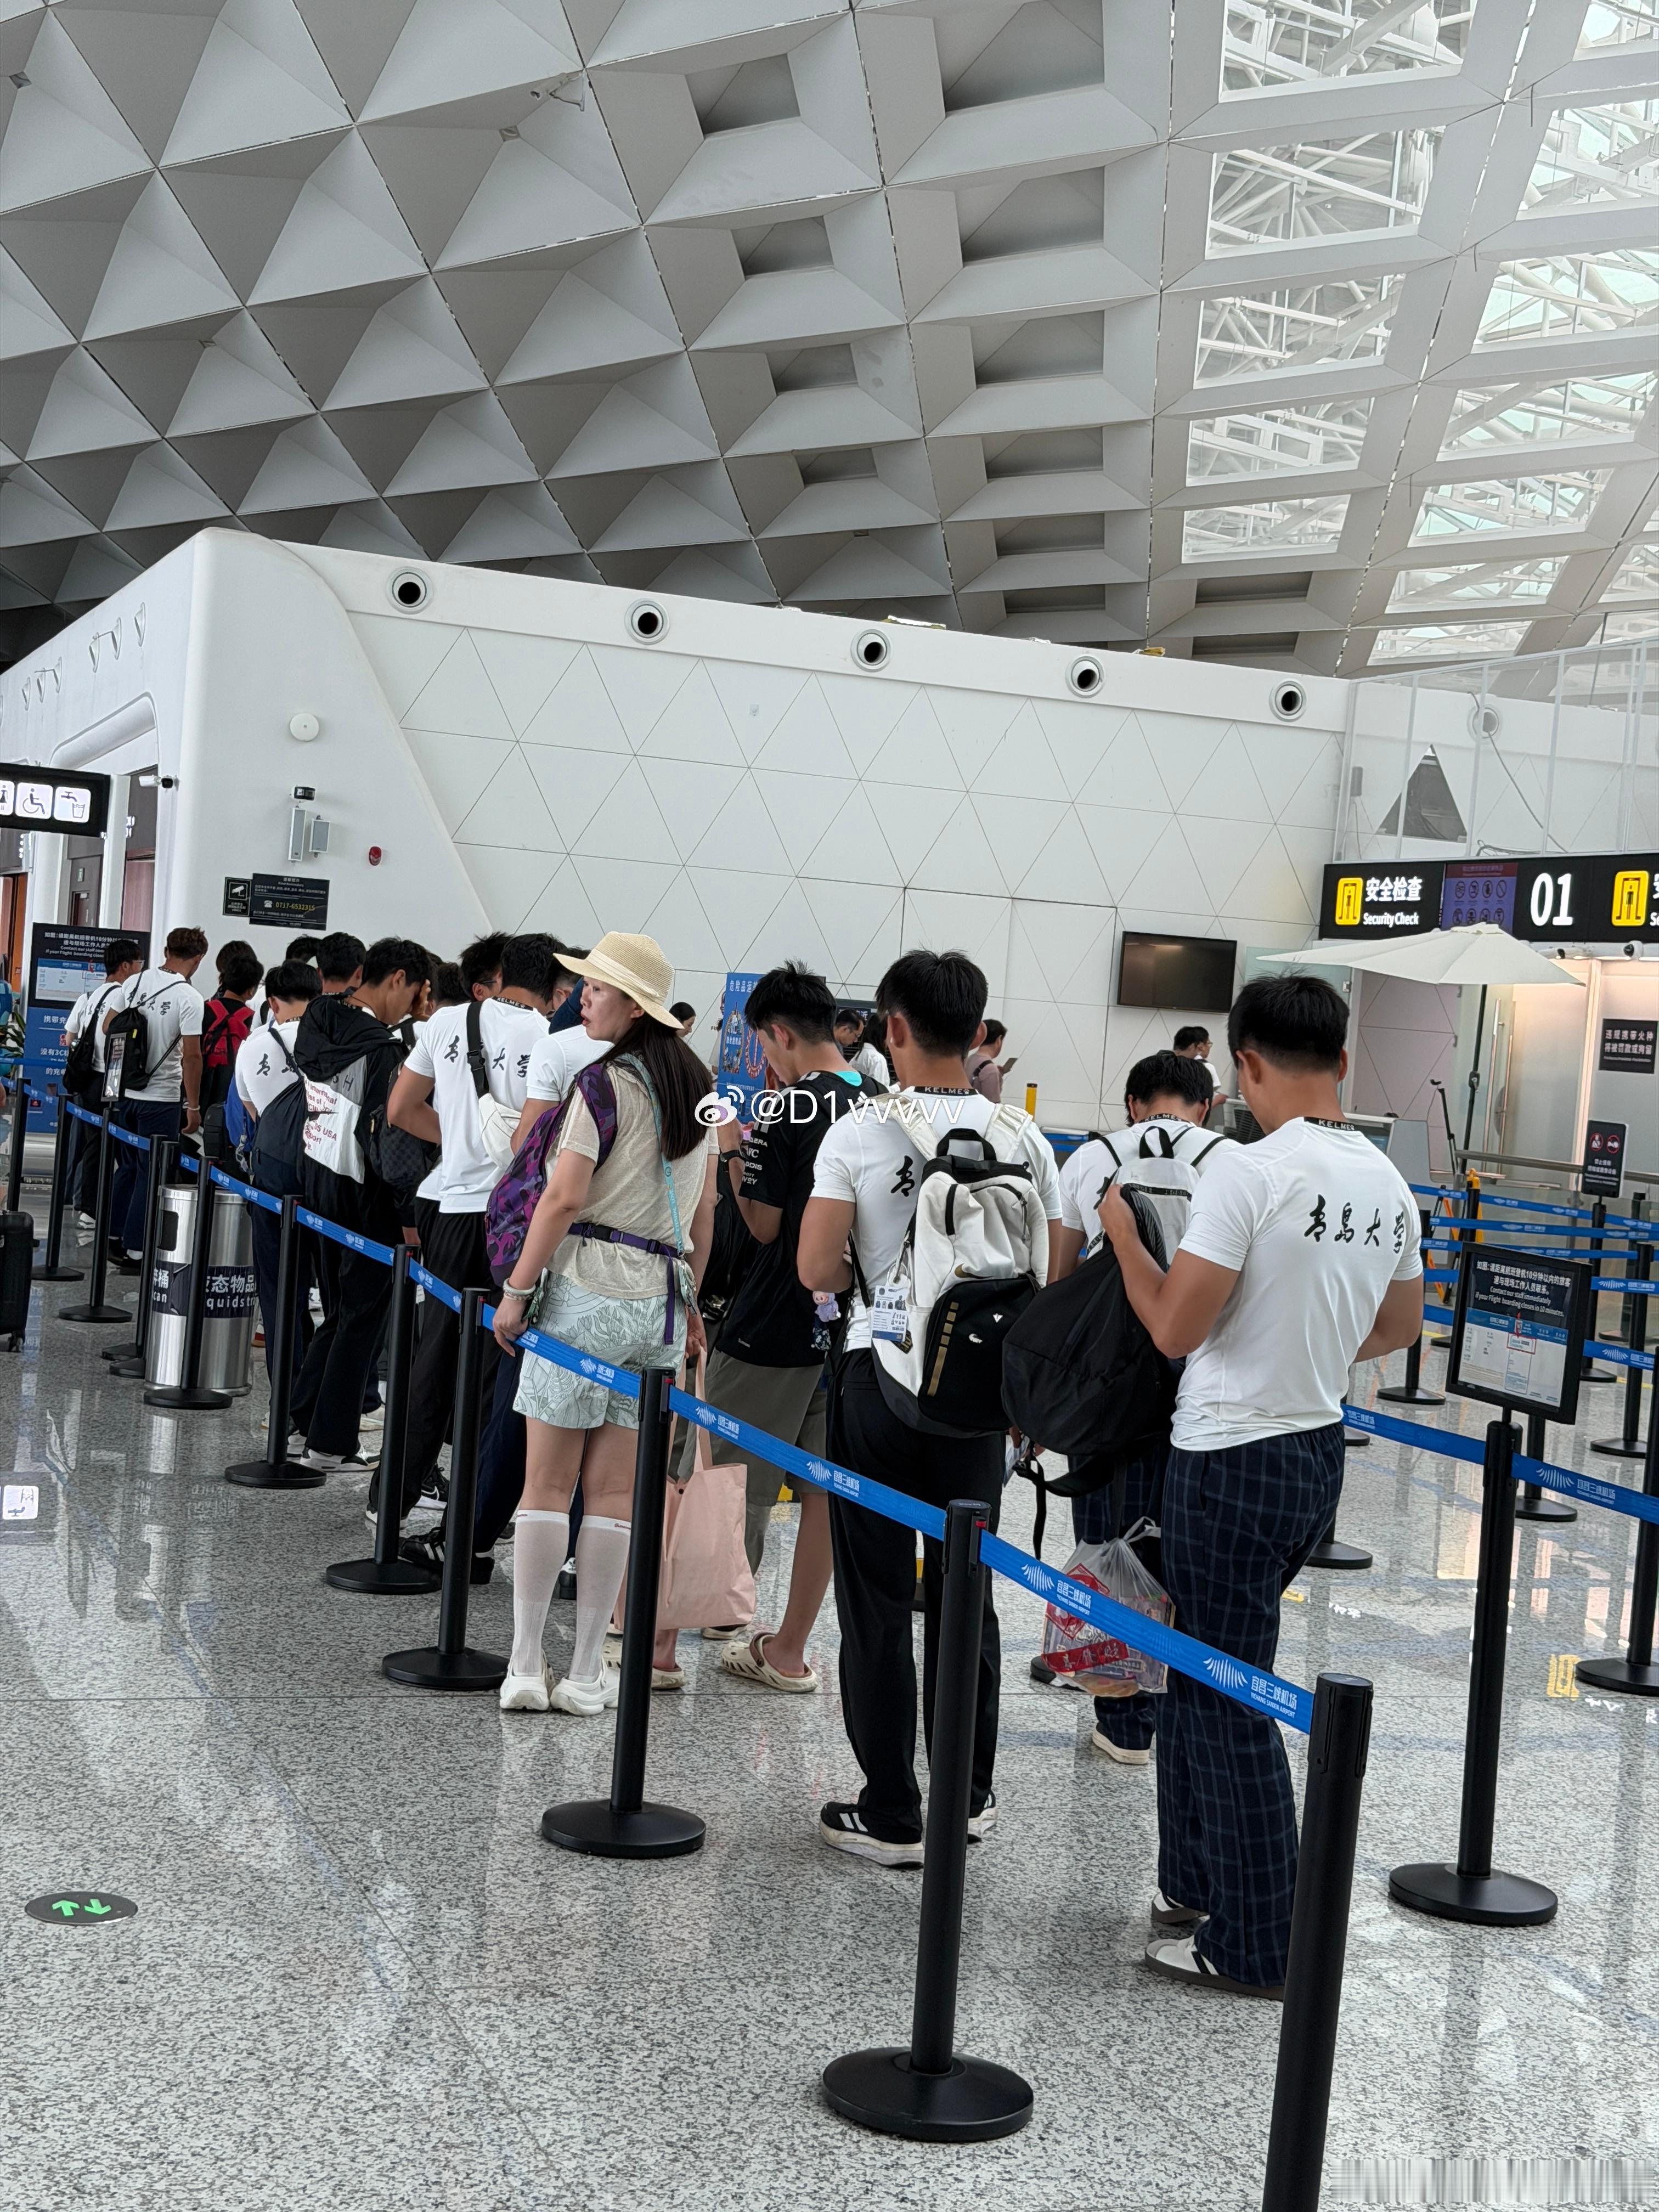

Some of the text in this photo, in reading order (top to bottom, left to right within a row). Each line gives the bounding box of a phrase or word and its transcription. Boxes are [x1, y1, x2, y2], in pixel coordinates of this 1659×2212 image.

[1365, 876, 1423, 901] 安全检查
[275, 901, 315, 911] 0717-6532315
[1530, 872, 1573, 926] 01
[1363, 912, 1419, 928] Security Check
[497, 997, 518, 1007] KELME
[444, 1035, 531, 1078] 青大学
[924, 1086, 963, 1094] KELME
[1144, 1114, 1176, 1122] KELME
[1318, 1119, 1350, 1131] KELME
[323, 1127, 337, 1141] USA
[1304, 1194, 1404, 1254] 青岛大学
[153, 1291, 167, 1303] can
[1488, 1294, 1501, 1304] Flight
[1502, 1297, 1521, 1309] boarding
[1521, 1302, 1534, 1310] closes
[1490, 1285, 1506, 1295] Contact
[1514, 1291, 1524, 1300] staff
[1524, 1292, 1551, 1306] immediately
[1577, 1479, 1616, 1500] 宜昌三峡机场
[1057, 1579, 1092, 1610] 宜昌三峡机场
[1251, 1675, 1297, 1711] 宜昌三峡机场
[1251, 1691, 1266, 1705] YICHANG
[1279, 1706, 1295, 1719] AIRPORT
